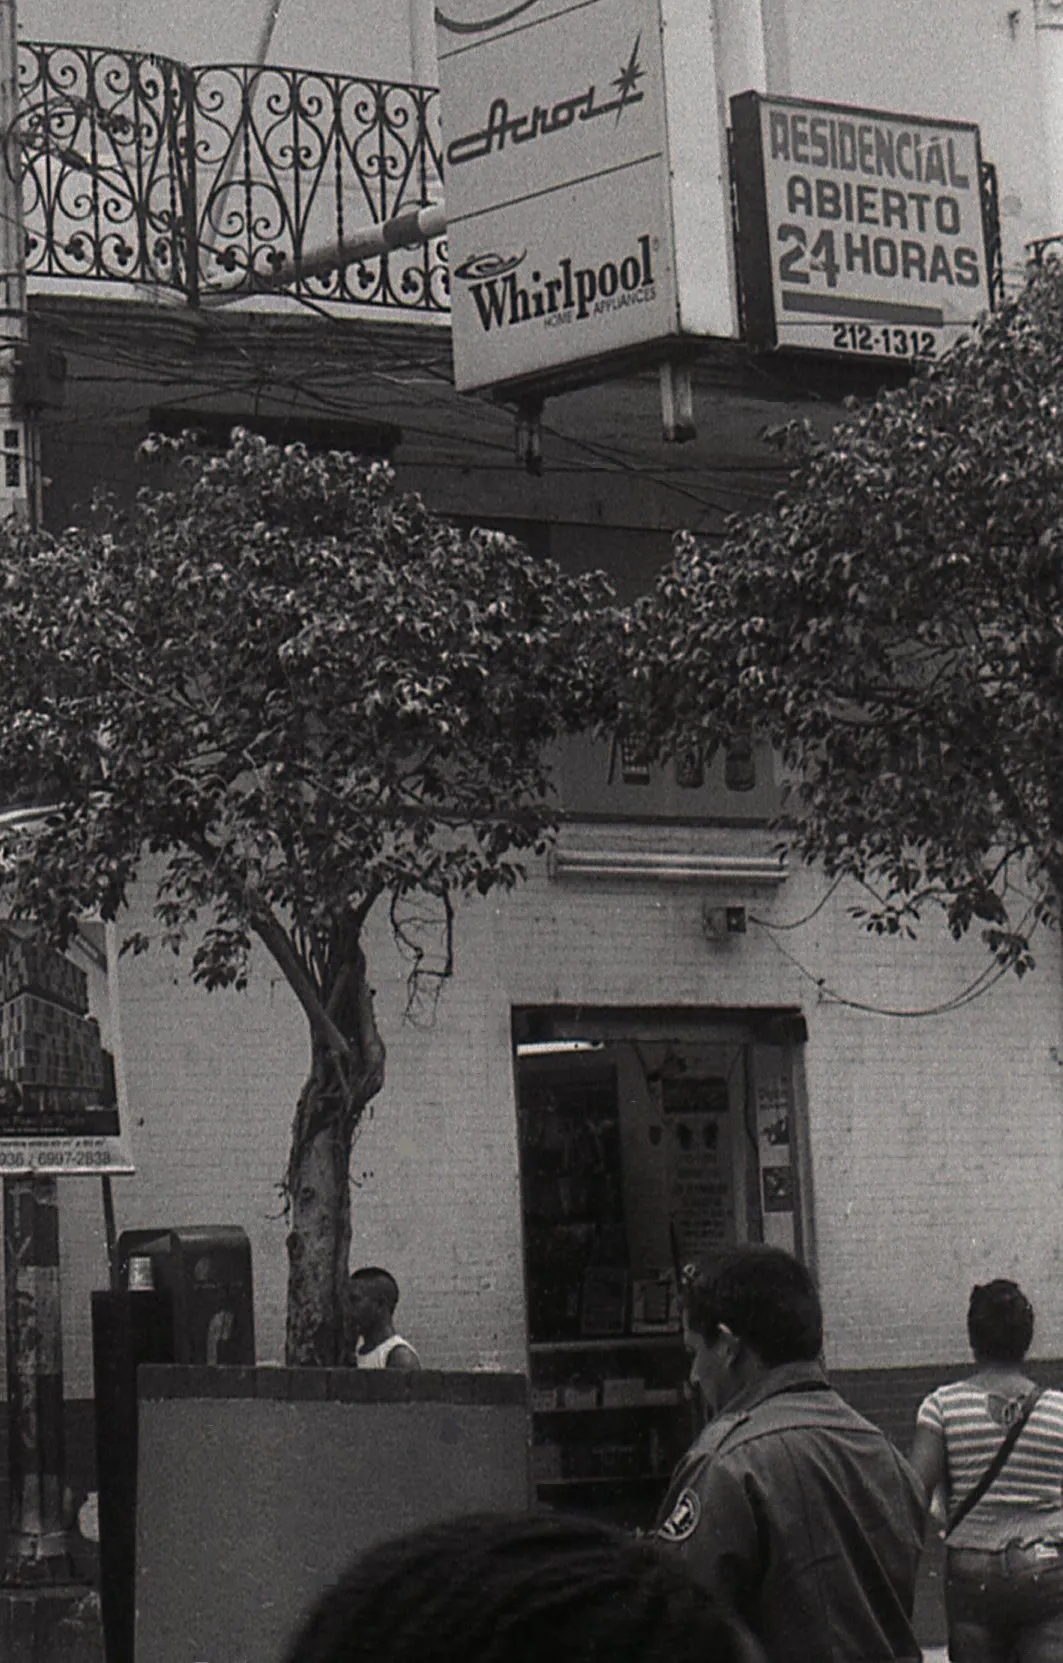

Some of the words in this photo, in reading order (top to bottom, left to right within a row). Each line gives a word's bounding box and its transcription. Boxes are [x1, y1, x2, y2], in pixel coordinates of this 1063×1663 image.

[787, 175, 961, 235] ABIERTO
[469, 235, 655, 333] Whirlpool
[777, 223, 839, 287] 24
[844, 233, 980, 287] HORAS
[593, 286, 657, 314] APPLIANCES
[833, 323, 937, 358] 212-1312
